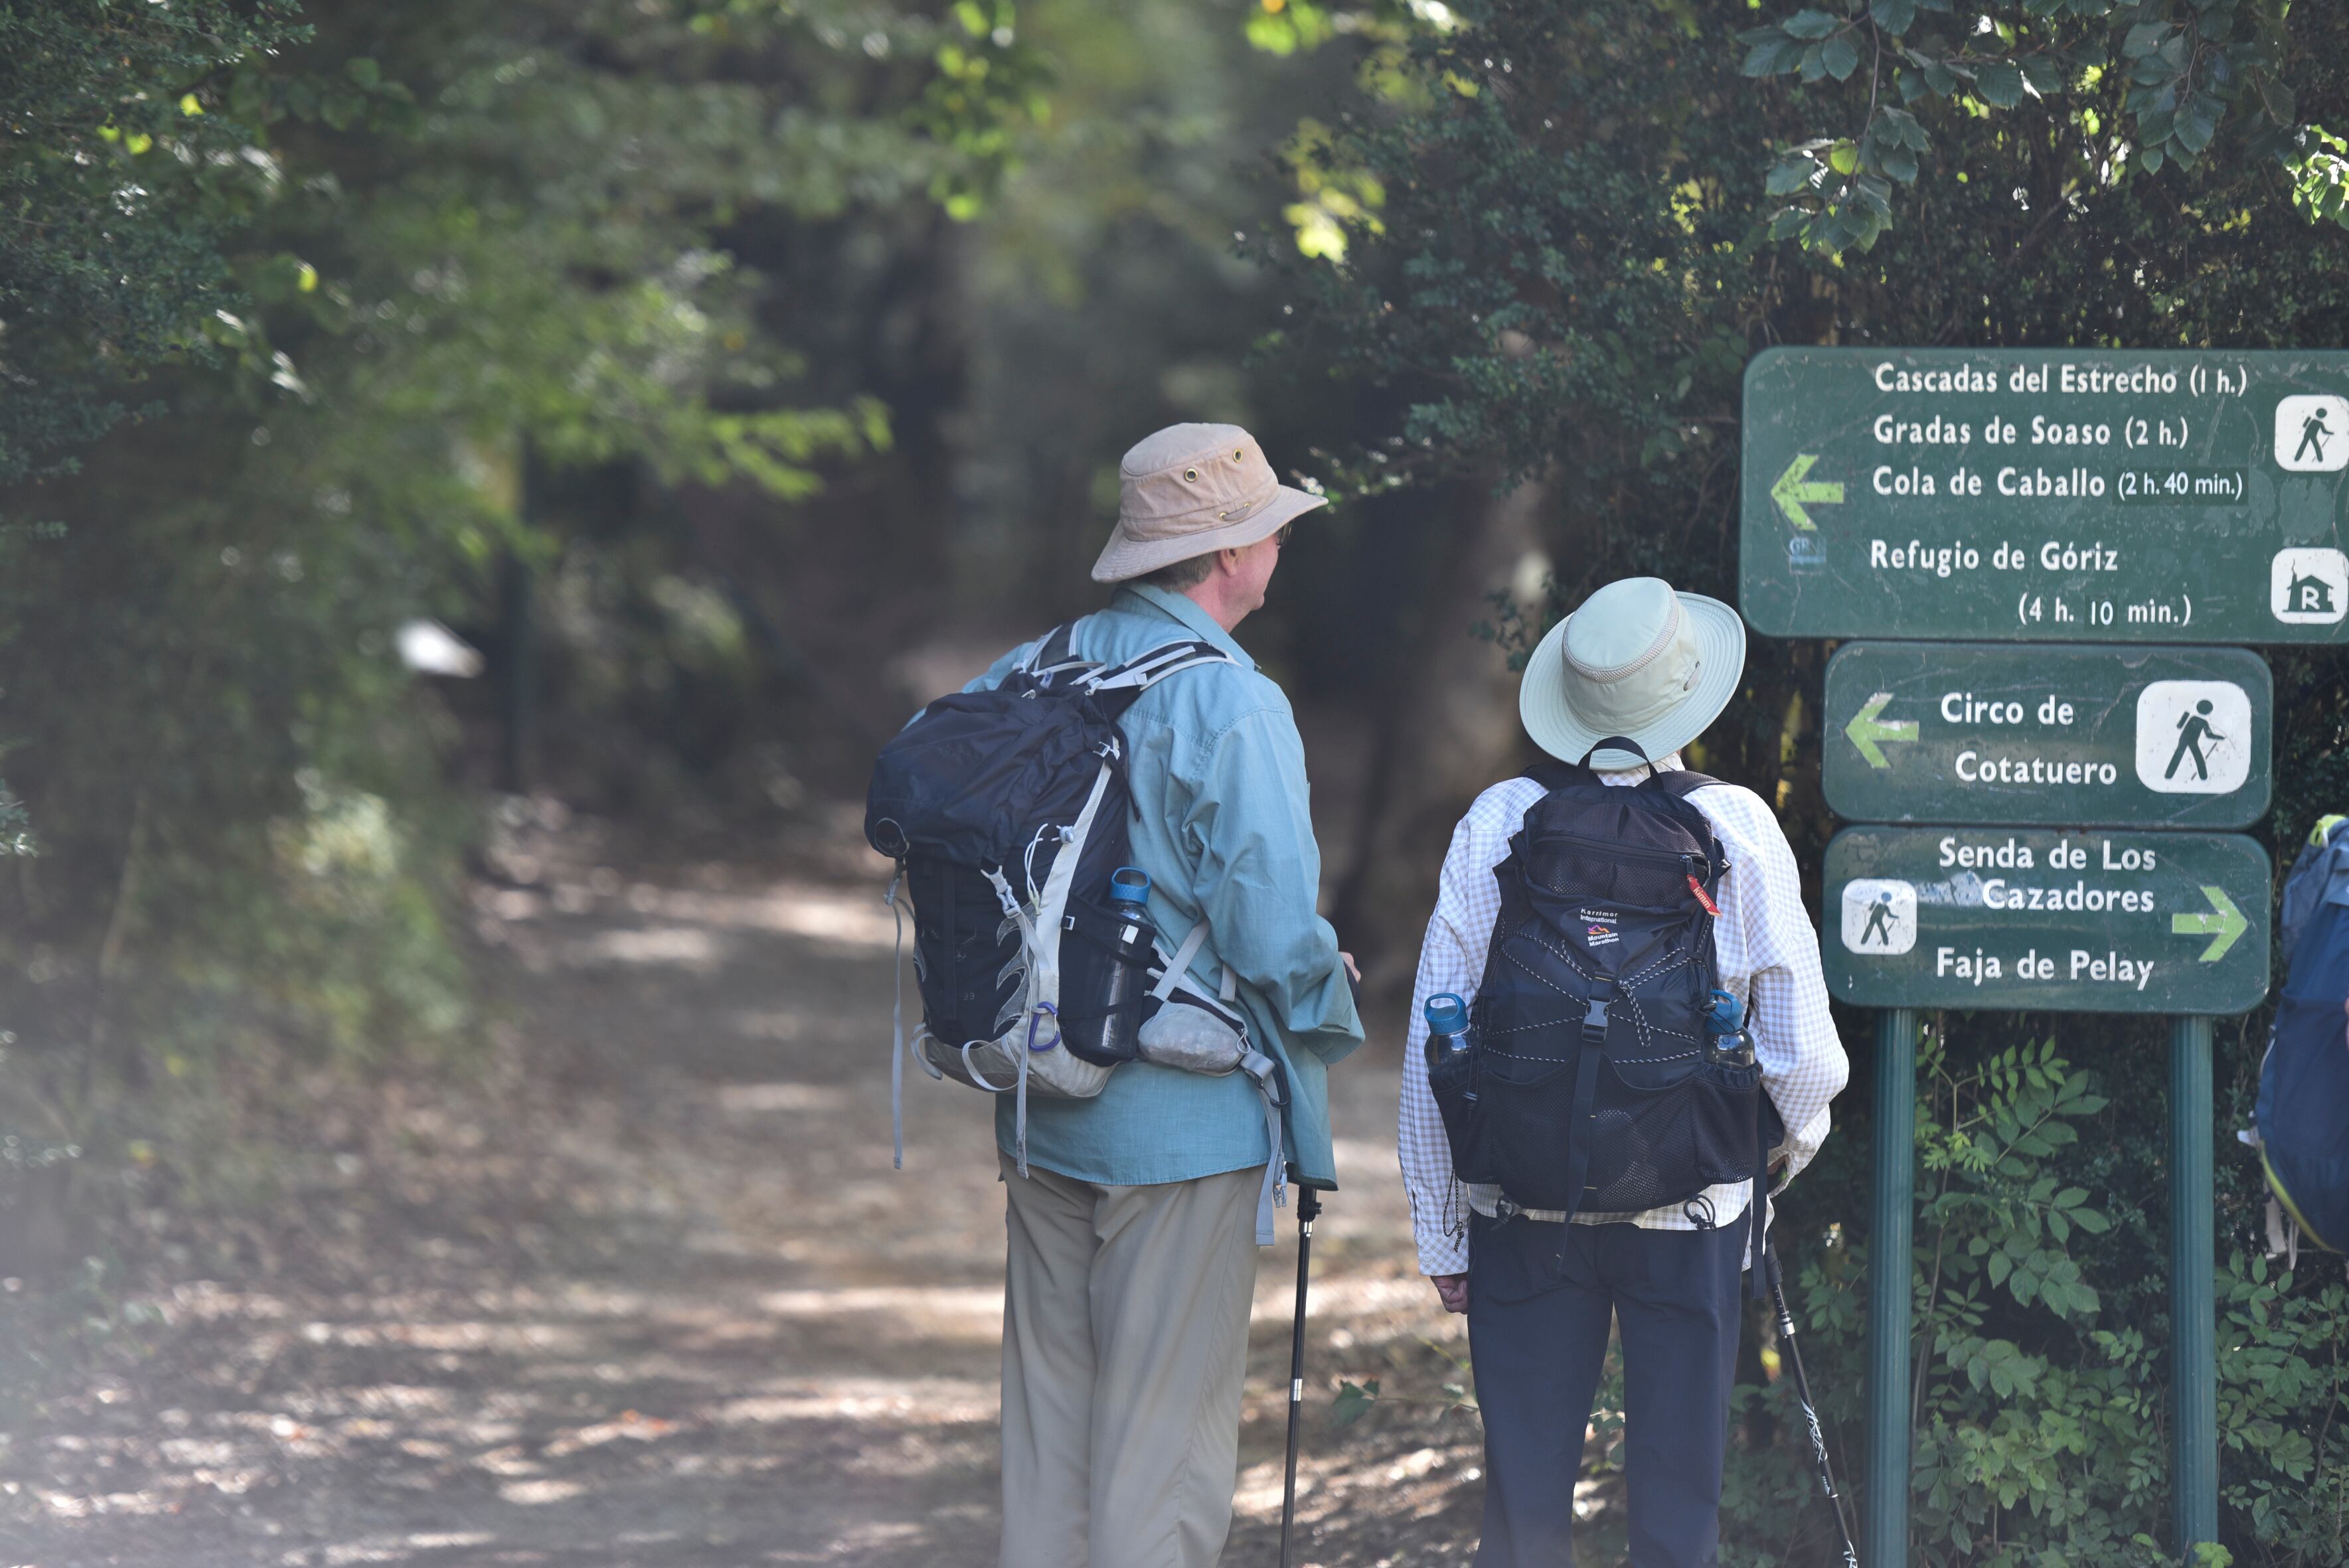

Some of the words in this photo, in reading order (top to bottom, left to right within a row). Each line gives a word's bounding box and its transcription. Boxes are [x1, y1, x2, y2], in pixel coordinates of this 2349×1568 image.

[1875, 362, 1997, 392] Cascadas
[2009, 363, 2048, 393] del
[2061, 364, 2177, 393] Estrecho
[2217, 364, 2247, 397] h.)
[1874, 414, 1971, 444] Gradas
[1984, 416, 2016, 444] de
[2032, 415, 2111, 445] Soaso
[2125, 416, 2148, 449] (2
[2159, 416, 2188, 449] h.)
[1873, 465, 1936, 495] Cola
[1950, 467, 1982, 496] de
[1997, 467, 2105, 497] Caballo
[2118, 472, 2137, 501] (2
[2144, 472, 2160, 495] h.
[2164, 472, 2189, 495] 40
[2195, 472, 2243, 501] min.)
[1871, 540, 1979, 578] Refugio
[1992, 541, 2025, 570] de
[2040, 541, 2118, 571] Góriz
[2018, 592, 2042, 625] (4
[2055, 597, 2074, 622] h.
[2091, 601, 2113, 625] 10
[2128, 594, 2192, 627] min.)
[1941, 692, 2024, 724] Circo
[2038, 694, 2073, 725] de
[1955, 751, 2117, 785] Cotatuero
[1939, 837, 2034, 868] Senda
[2049, 838, 2087, 870] de
[2103, 840, 2156, 870] Los
[1693, 887, 1711, 909] kimm
[1981, 878, 2154, 912] Cazadores
[1580, 914, 1617, 924] International
[1581, 908, 1618, 917] Karrimor
[1587, 933, 1618, 941] Mountain
[1589, 937, 1619, 947] Marathon
[1937, 947, 2002, 986] Faja
[2017, 949, 2054, 980] de
[2070, 950, 2154, 990] Pelay
